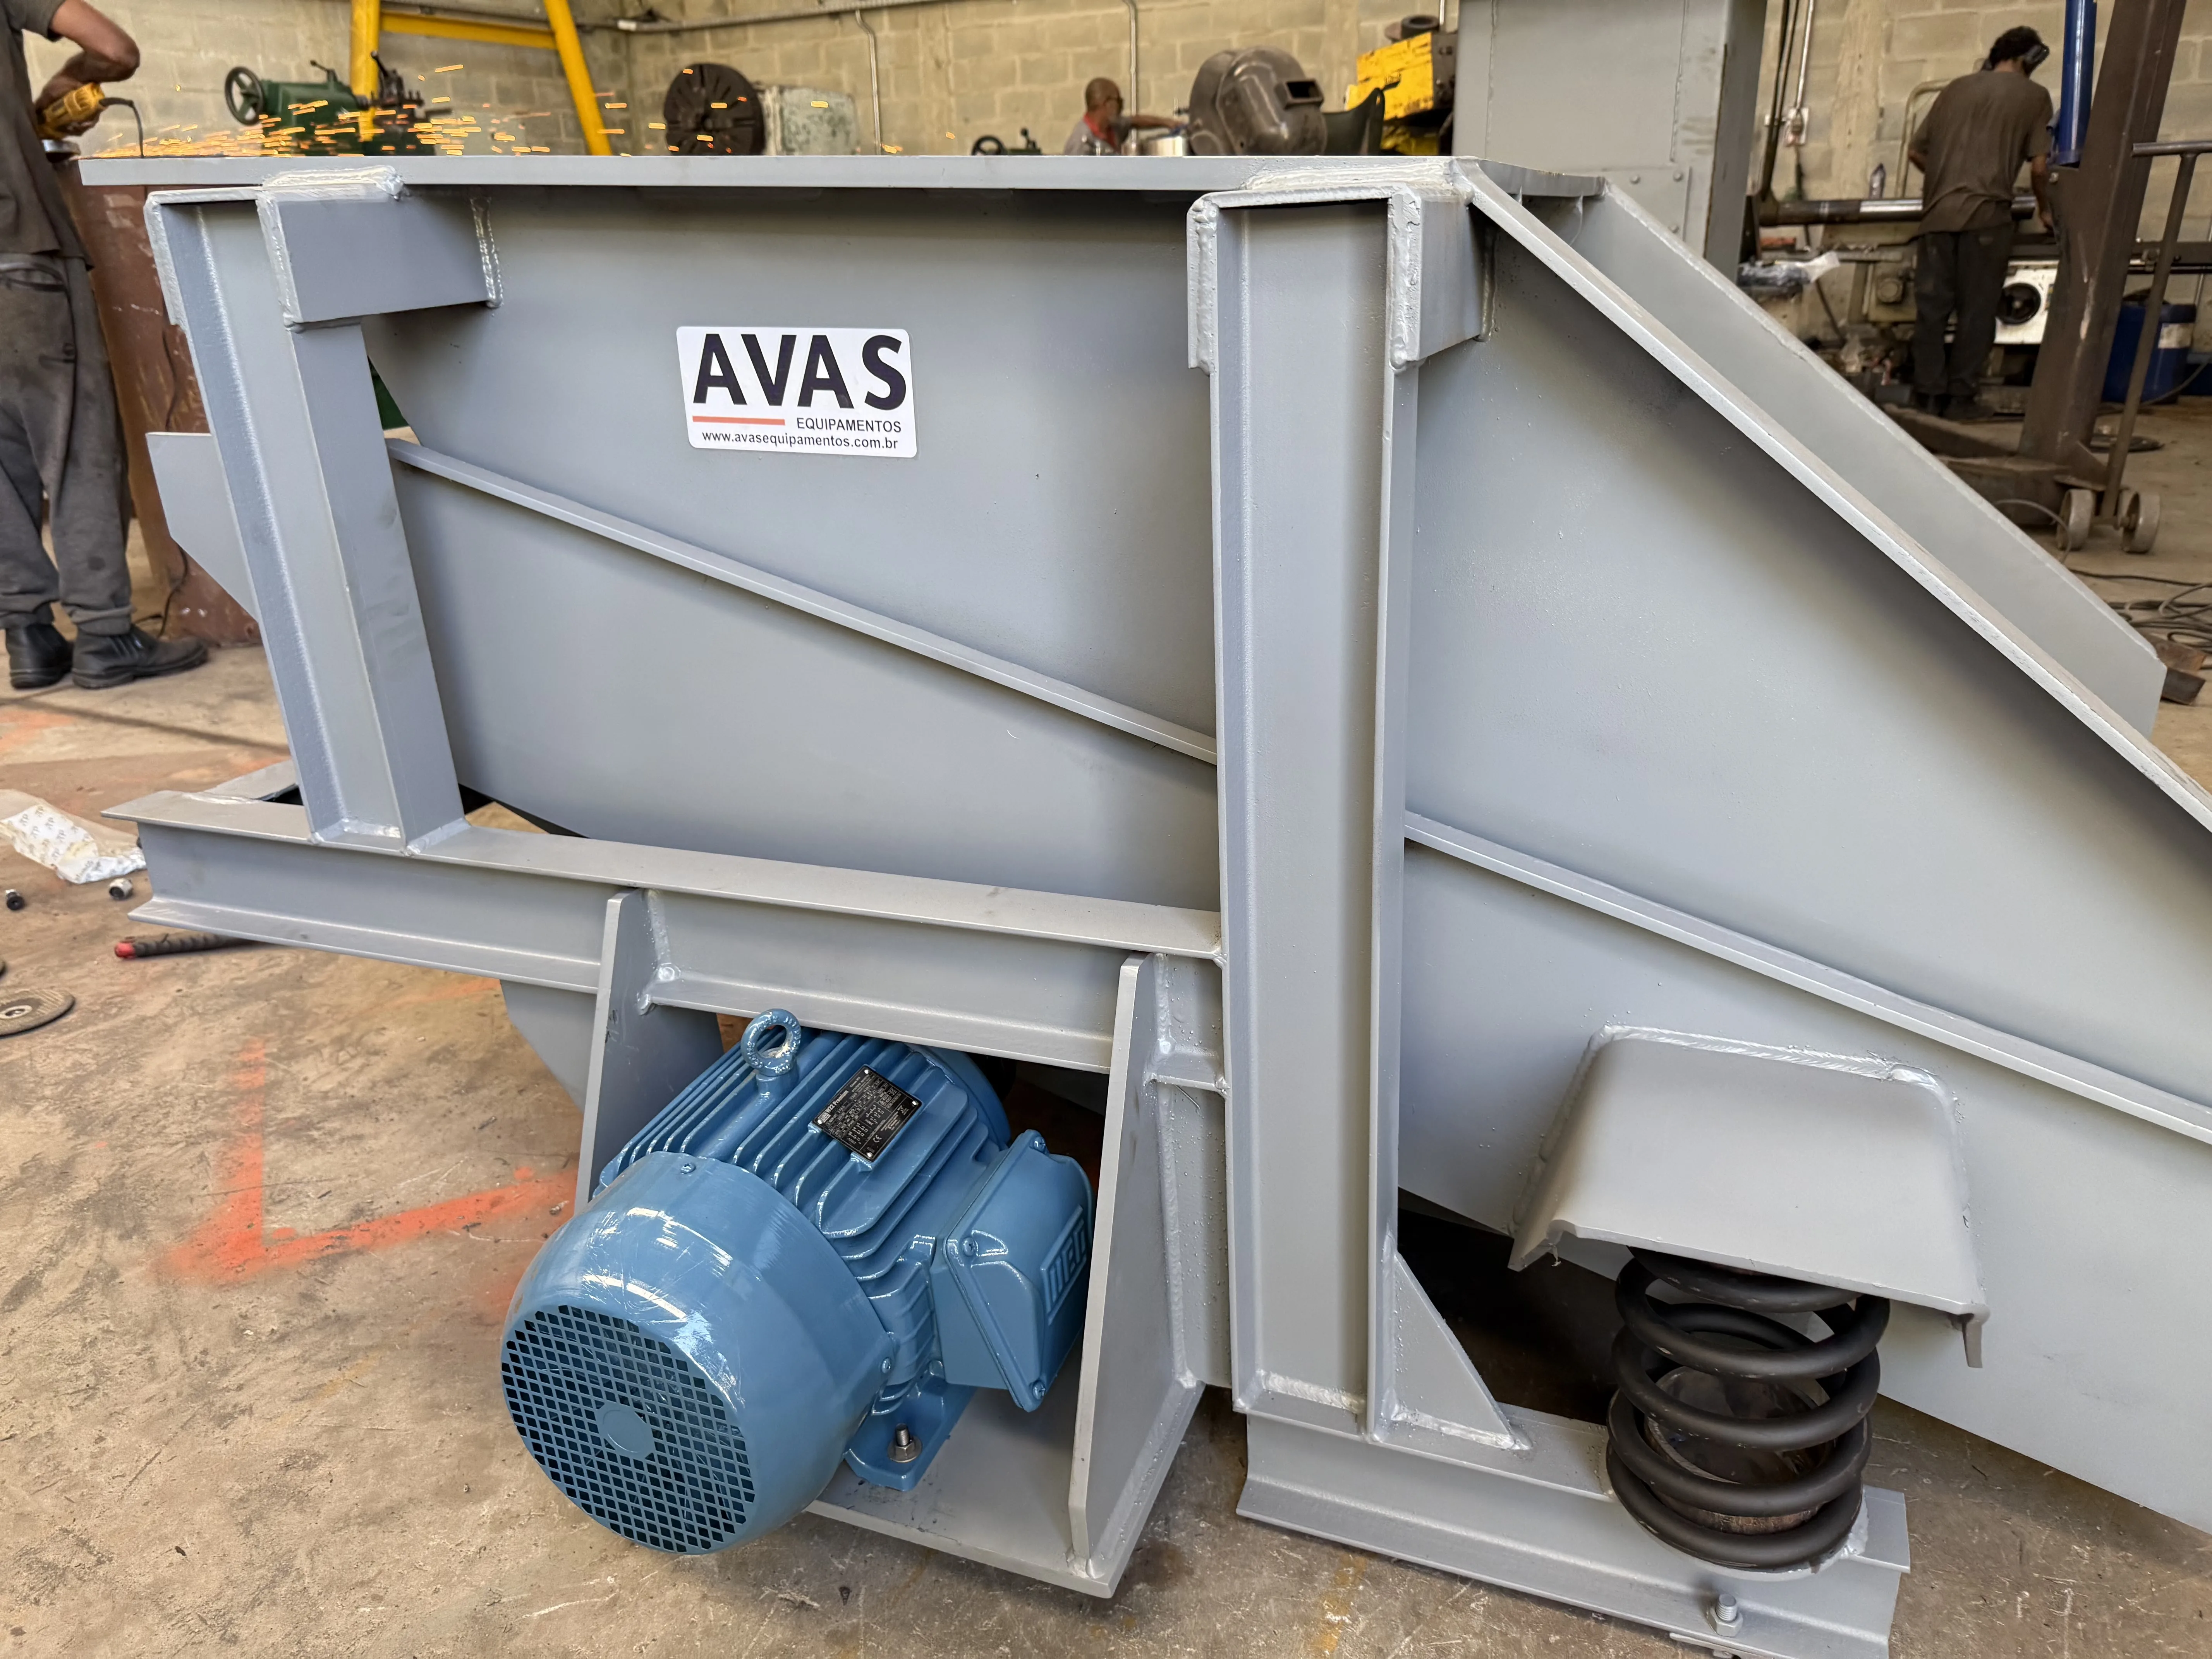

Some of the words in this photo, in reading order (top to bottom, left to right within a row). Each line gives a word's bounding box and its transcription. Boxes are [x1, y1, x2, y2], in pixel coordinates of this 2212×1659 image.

[693, 333, 907, 410] AVAS
[797, 417, 902, 433] EQUIPAMENTOS
[702, 431, 898, 449] www.avasequipamentos.com.br
[833, 1090, 849, 1106] Premium
